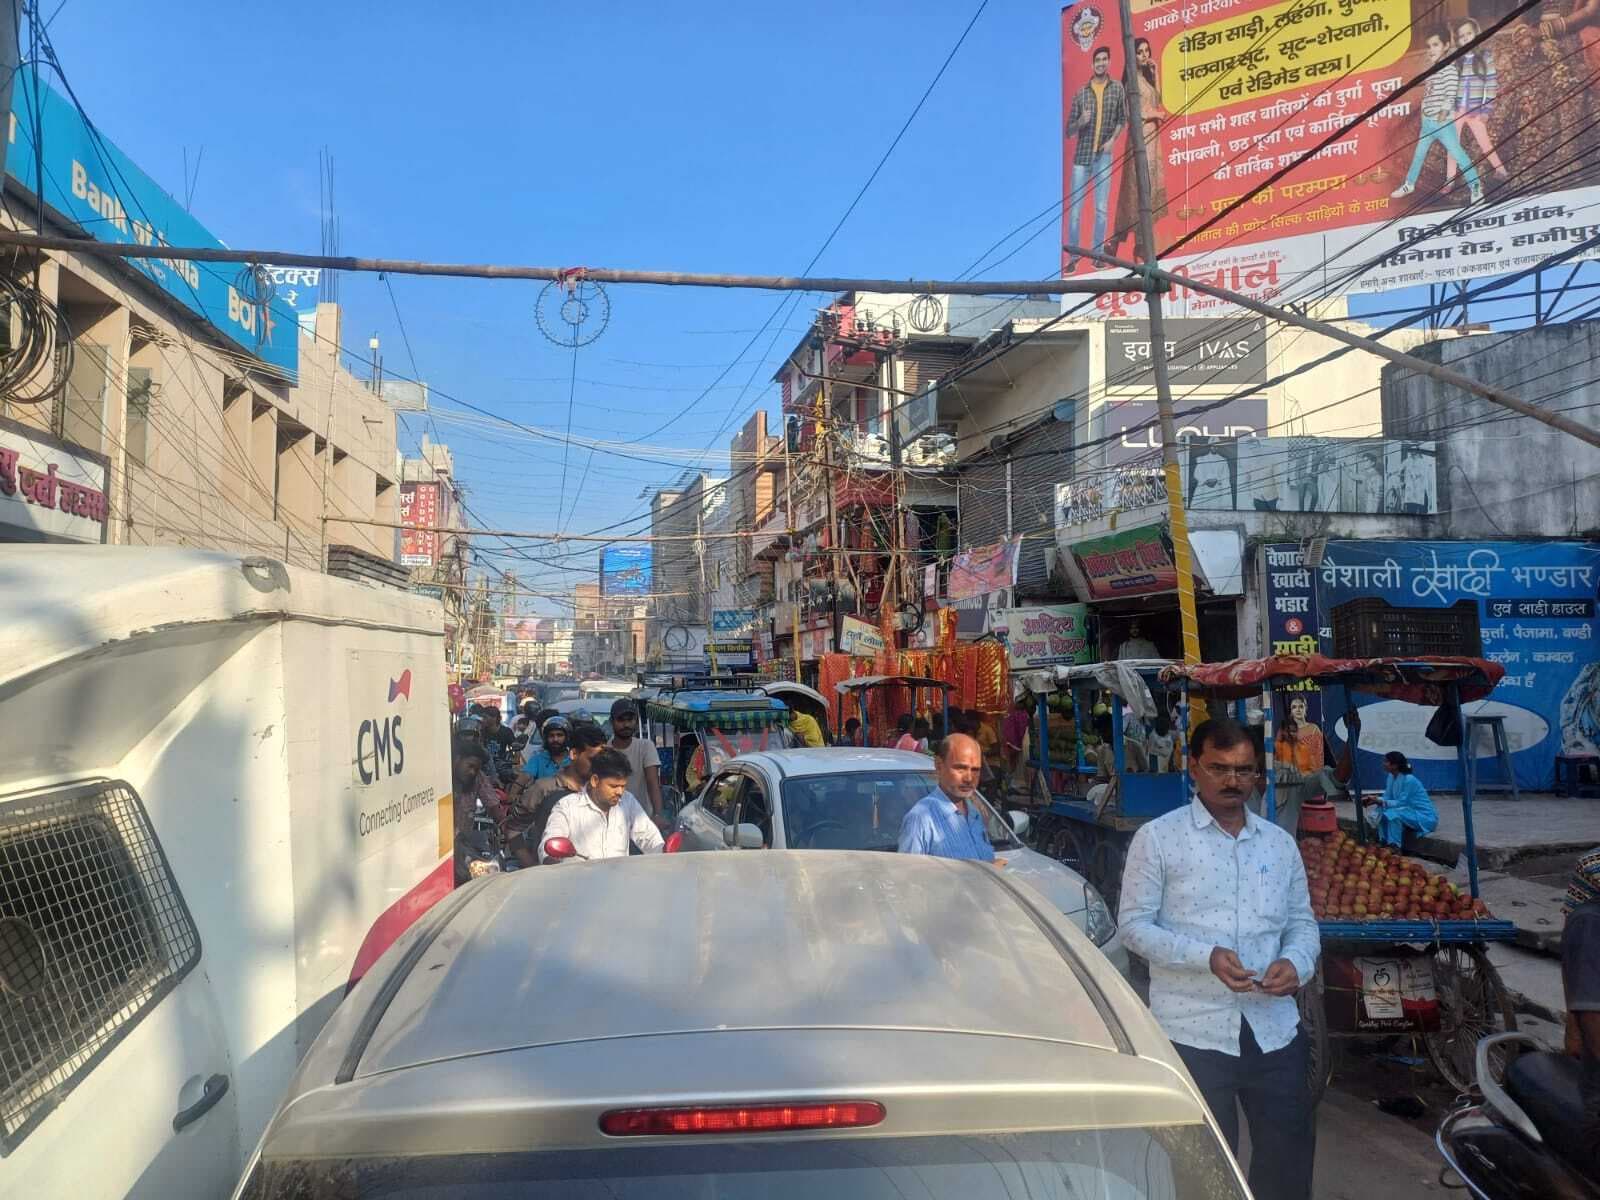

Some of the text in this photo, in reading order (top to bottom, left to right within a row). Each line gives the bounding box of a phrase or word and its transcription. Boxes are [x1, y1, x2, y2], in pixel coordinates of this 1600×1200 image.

[1225, 15, 1270, 40] साड़ी,
[1278, 13, 1389, 60] सूट-शेरवानी,
[1219, 78, 1243, 100] एवं
[1169, 124, 1197, 141] आप
[1200, 113, 1227, 134] सभी
[1230, 110, 1257, 128] शहर
[1336, 79, 1363, 108] दुर्गा
[1229, 137, 1250, 152] छठ
[1253, 130, 1282, 151] पूजा
[1285, 119, 1305, 142] एवं
[1234, 154, 1274, 177] हार्दिक
[72, 159, 128, 235] Bank
[1458, 239, 1503, 256] रोड,
[228, 286, 256, 336] BOI
[18, 463, 58, 510] पर्दा
[1266, 546, 1311, 567] वैशाल
[1271, 568, 1311, 588] खादी
[1320, 556, 1402, 588] वैशाली
[1511, 566, 1593, 589] भण्डार
[1275, 592, 1310, 612] भंडार
[1493, 600, 1587, 617] एवं साड़ी हाउस
[1289, 621, 1298, 632] &
[357, 715, 404, 785] CMS
[359, 786, 434, 837] Connecting Commerce
